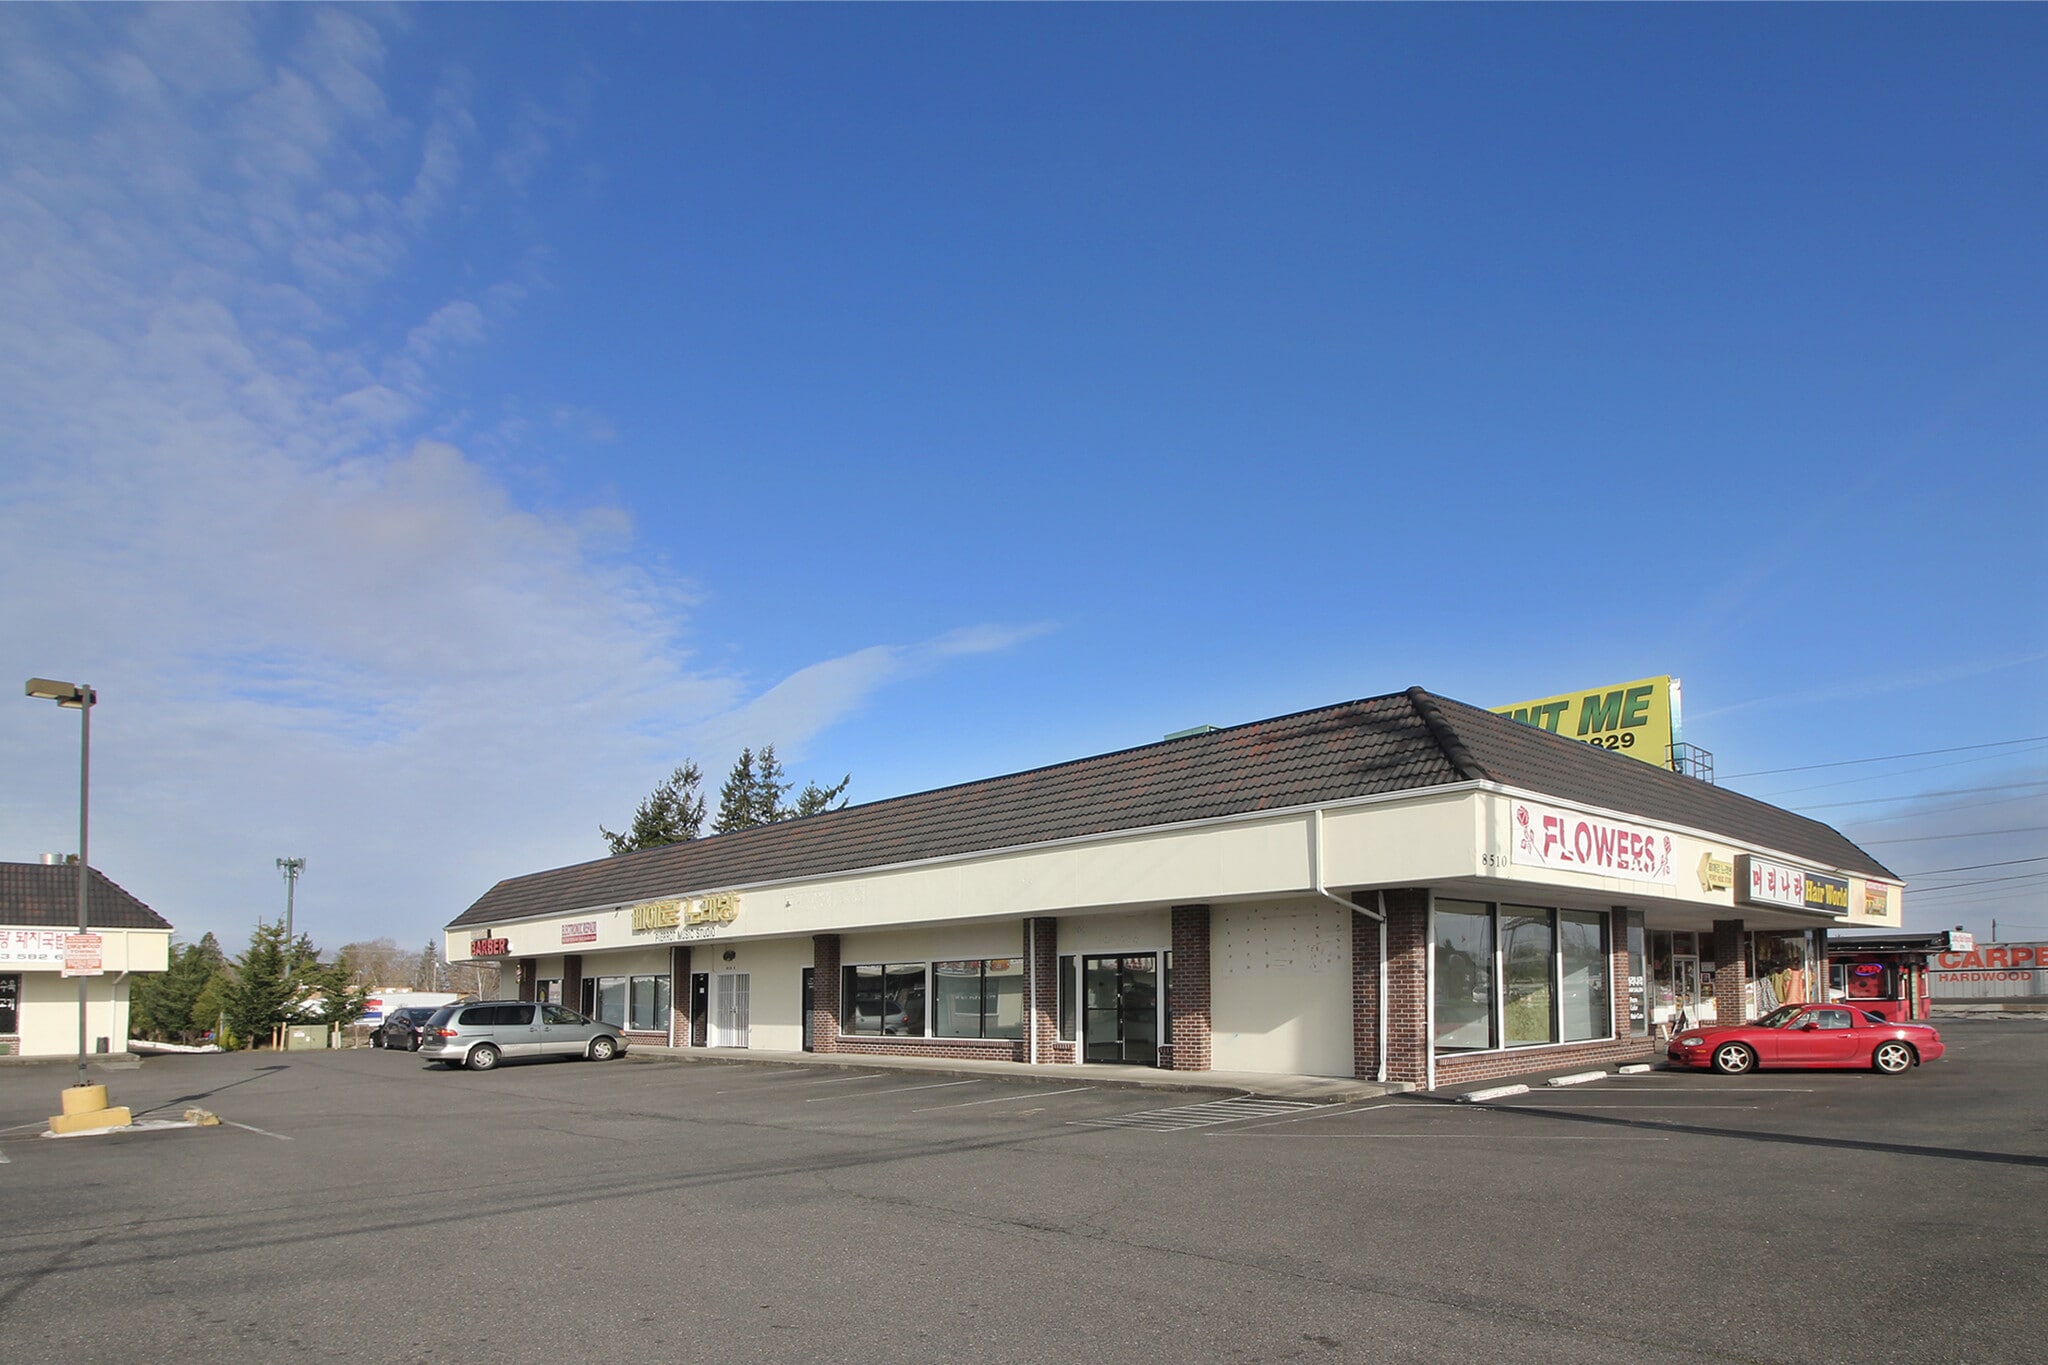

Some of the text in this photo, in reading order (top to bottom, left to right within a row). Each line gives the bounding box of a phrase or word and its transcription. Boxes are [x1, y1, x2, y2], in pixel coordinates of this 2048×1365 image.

[1499, 684, 1654, 736] NT ME
[1579, 732, 1635, 750] 829
[1543, 815, 1656, 873] FLOWERS
[1482, 853, 1507, 868] 8510
[1806, 879, 1848, 907] Hair World
[684, 894, 739, 925] 노래방
[471, 938, 506, 957] BARBER
[1856, 965, 1881, 974] OPEN
[1938, 971, 2032, 983] HARDWOOD
